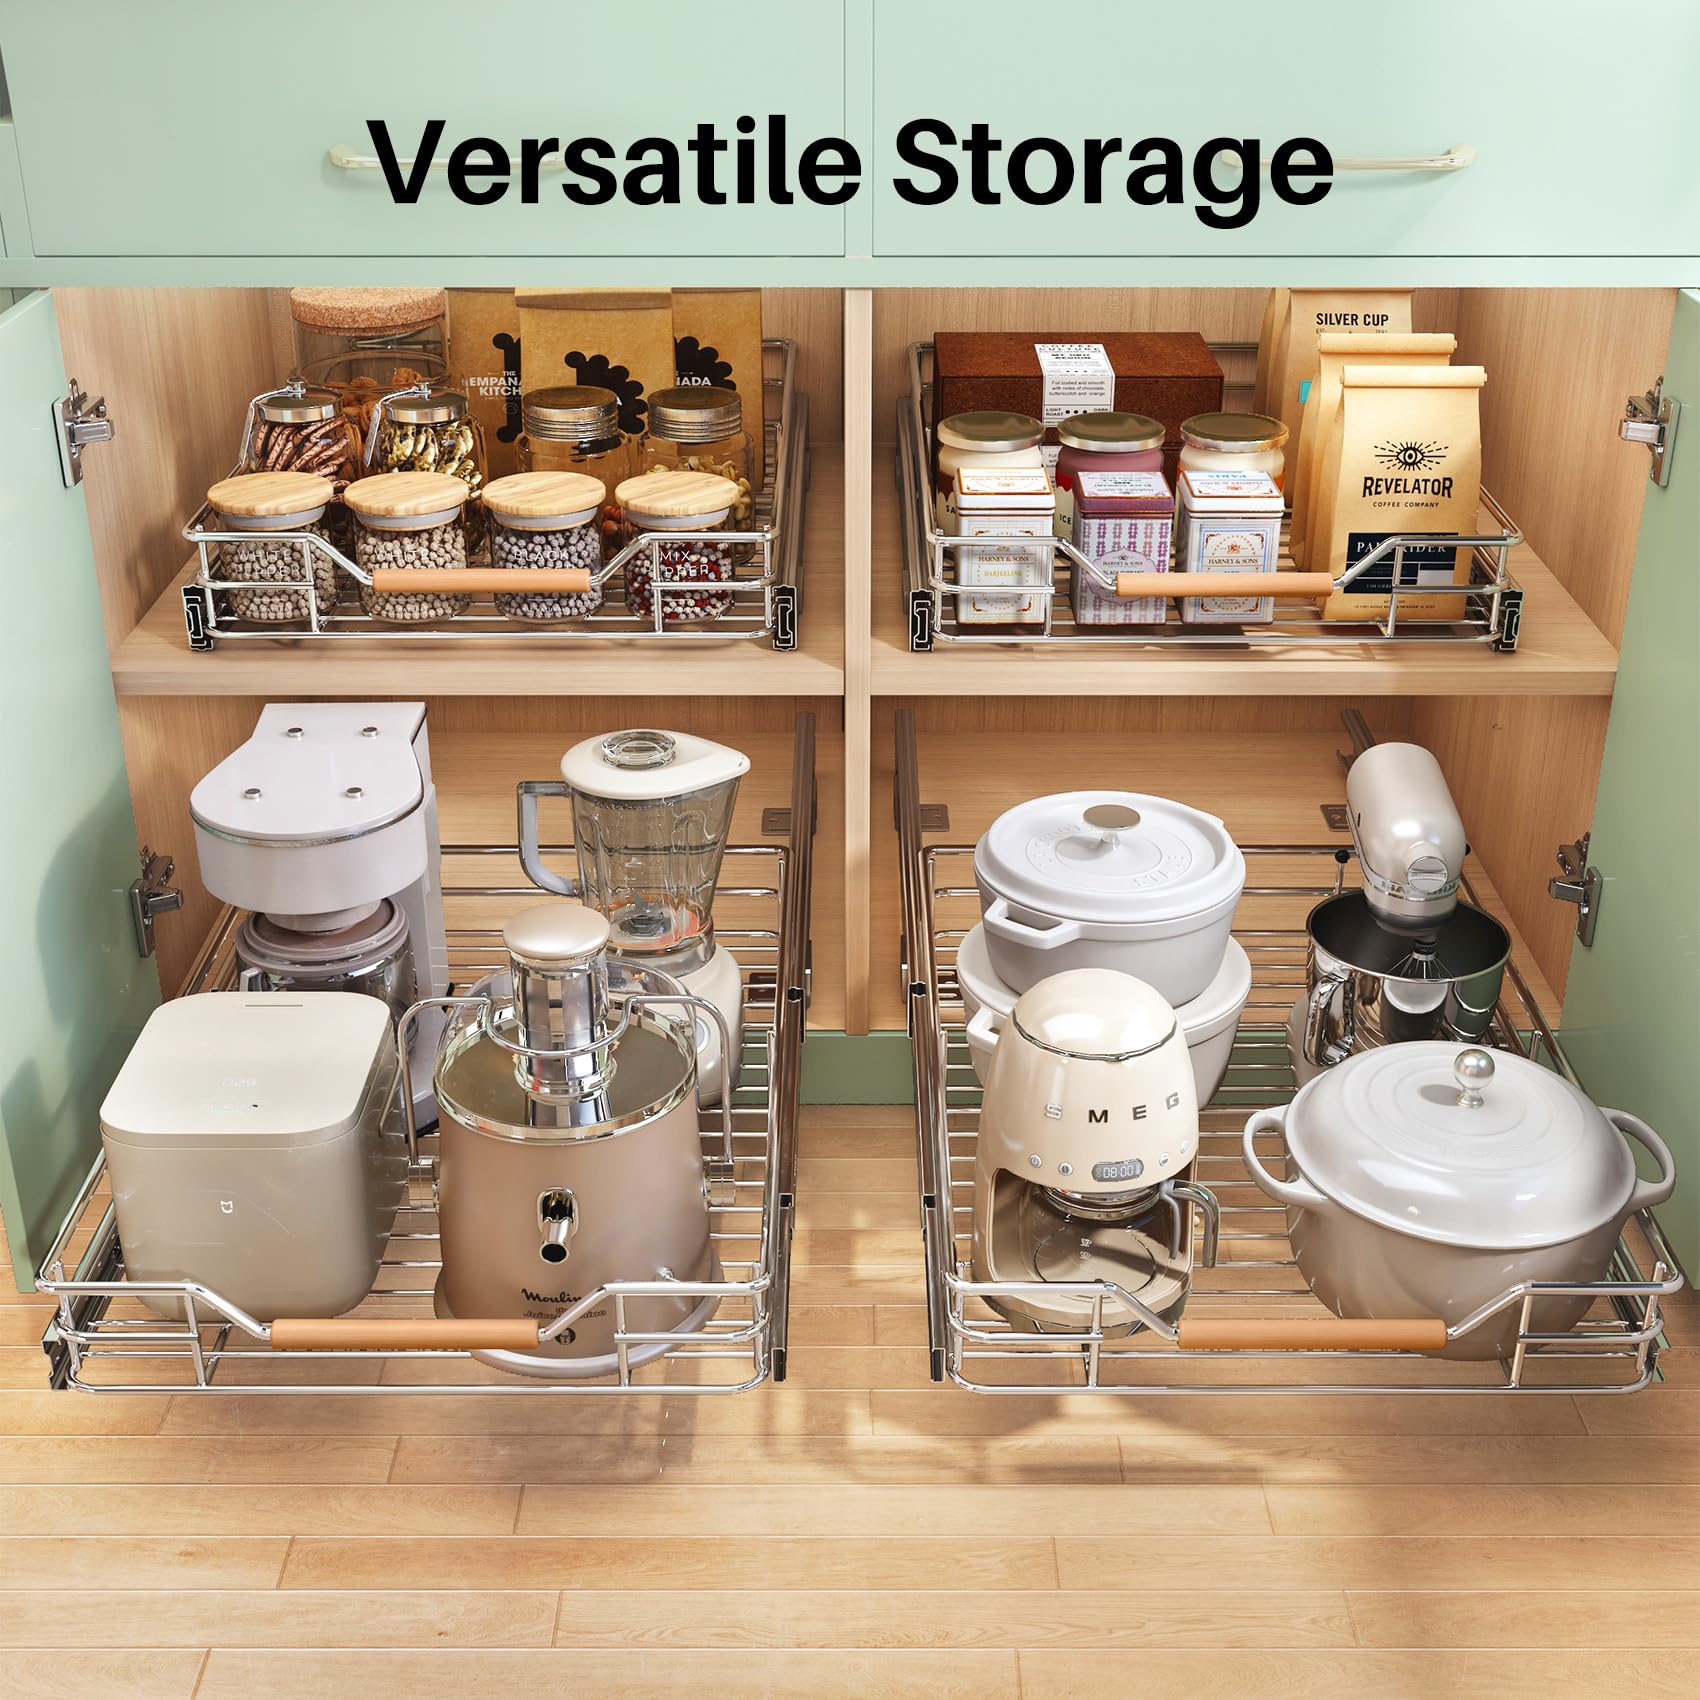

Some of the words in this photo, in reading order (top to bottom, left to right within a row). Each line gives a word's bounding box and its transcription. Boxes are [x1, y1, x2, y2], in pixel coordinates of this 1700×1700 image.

[1316, 313, 1359, 326] SILVER
[1363, 313, 1389, 326] CUP
[479, 386, 522, 396] KITCH
[1362, 476, 1454, 498] REVELATOR
[236, 549, 293, 561] WHITE
[374, 549, 430, 561] WHITE
[513, 549, 569, 561] BLACK
[660, 550, 690, 561] MIX
[234, 564, 300, 577] PEPPER
[1044, 1092, 1180, 1123] SMEG
[521, 1288, 582, 1303] Moulin
